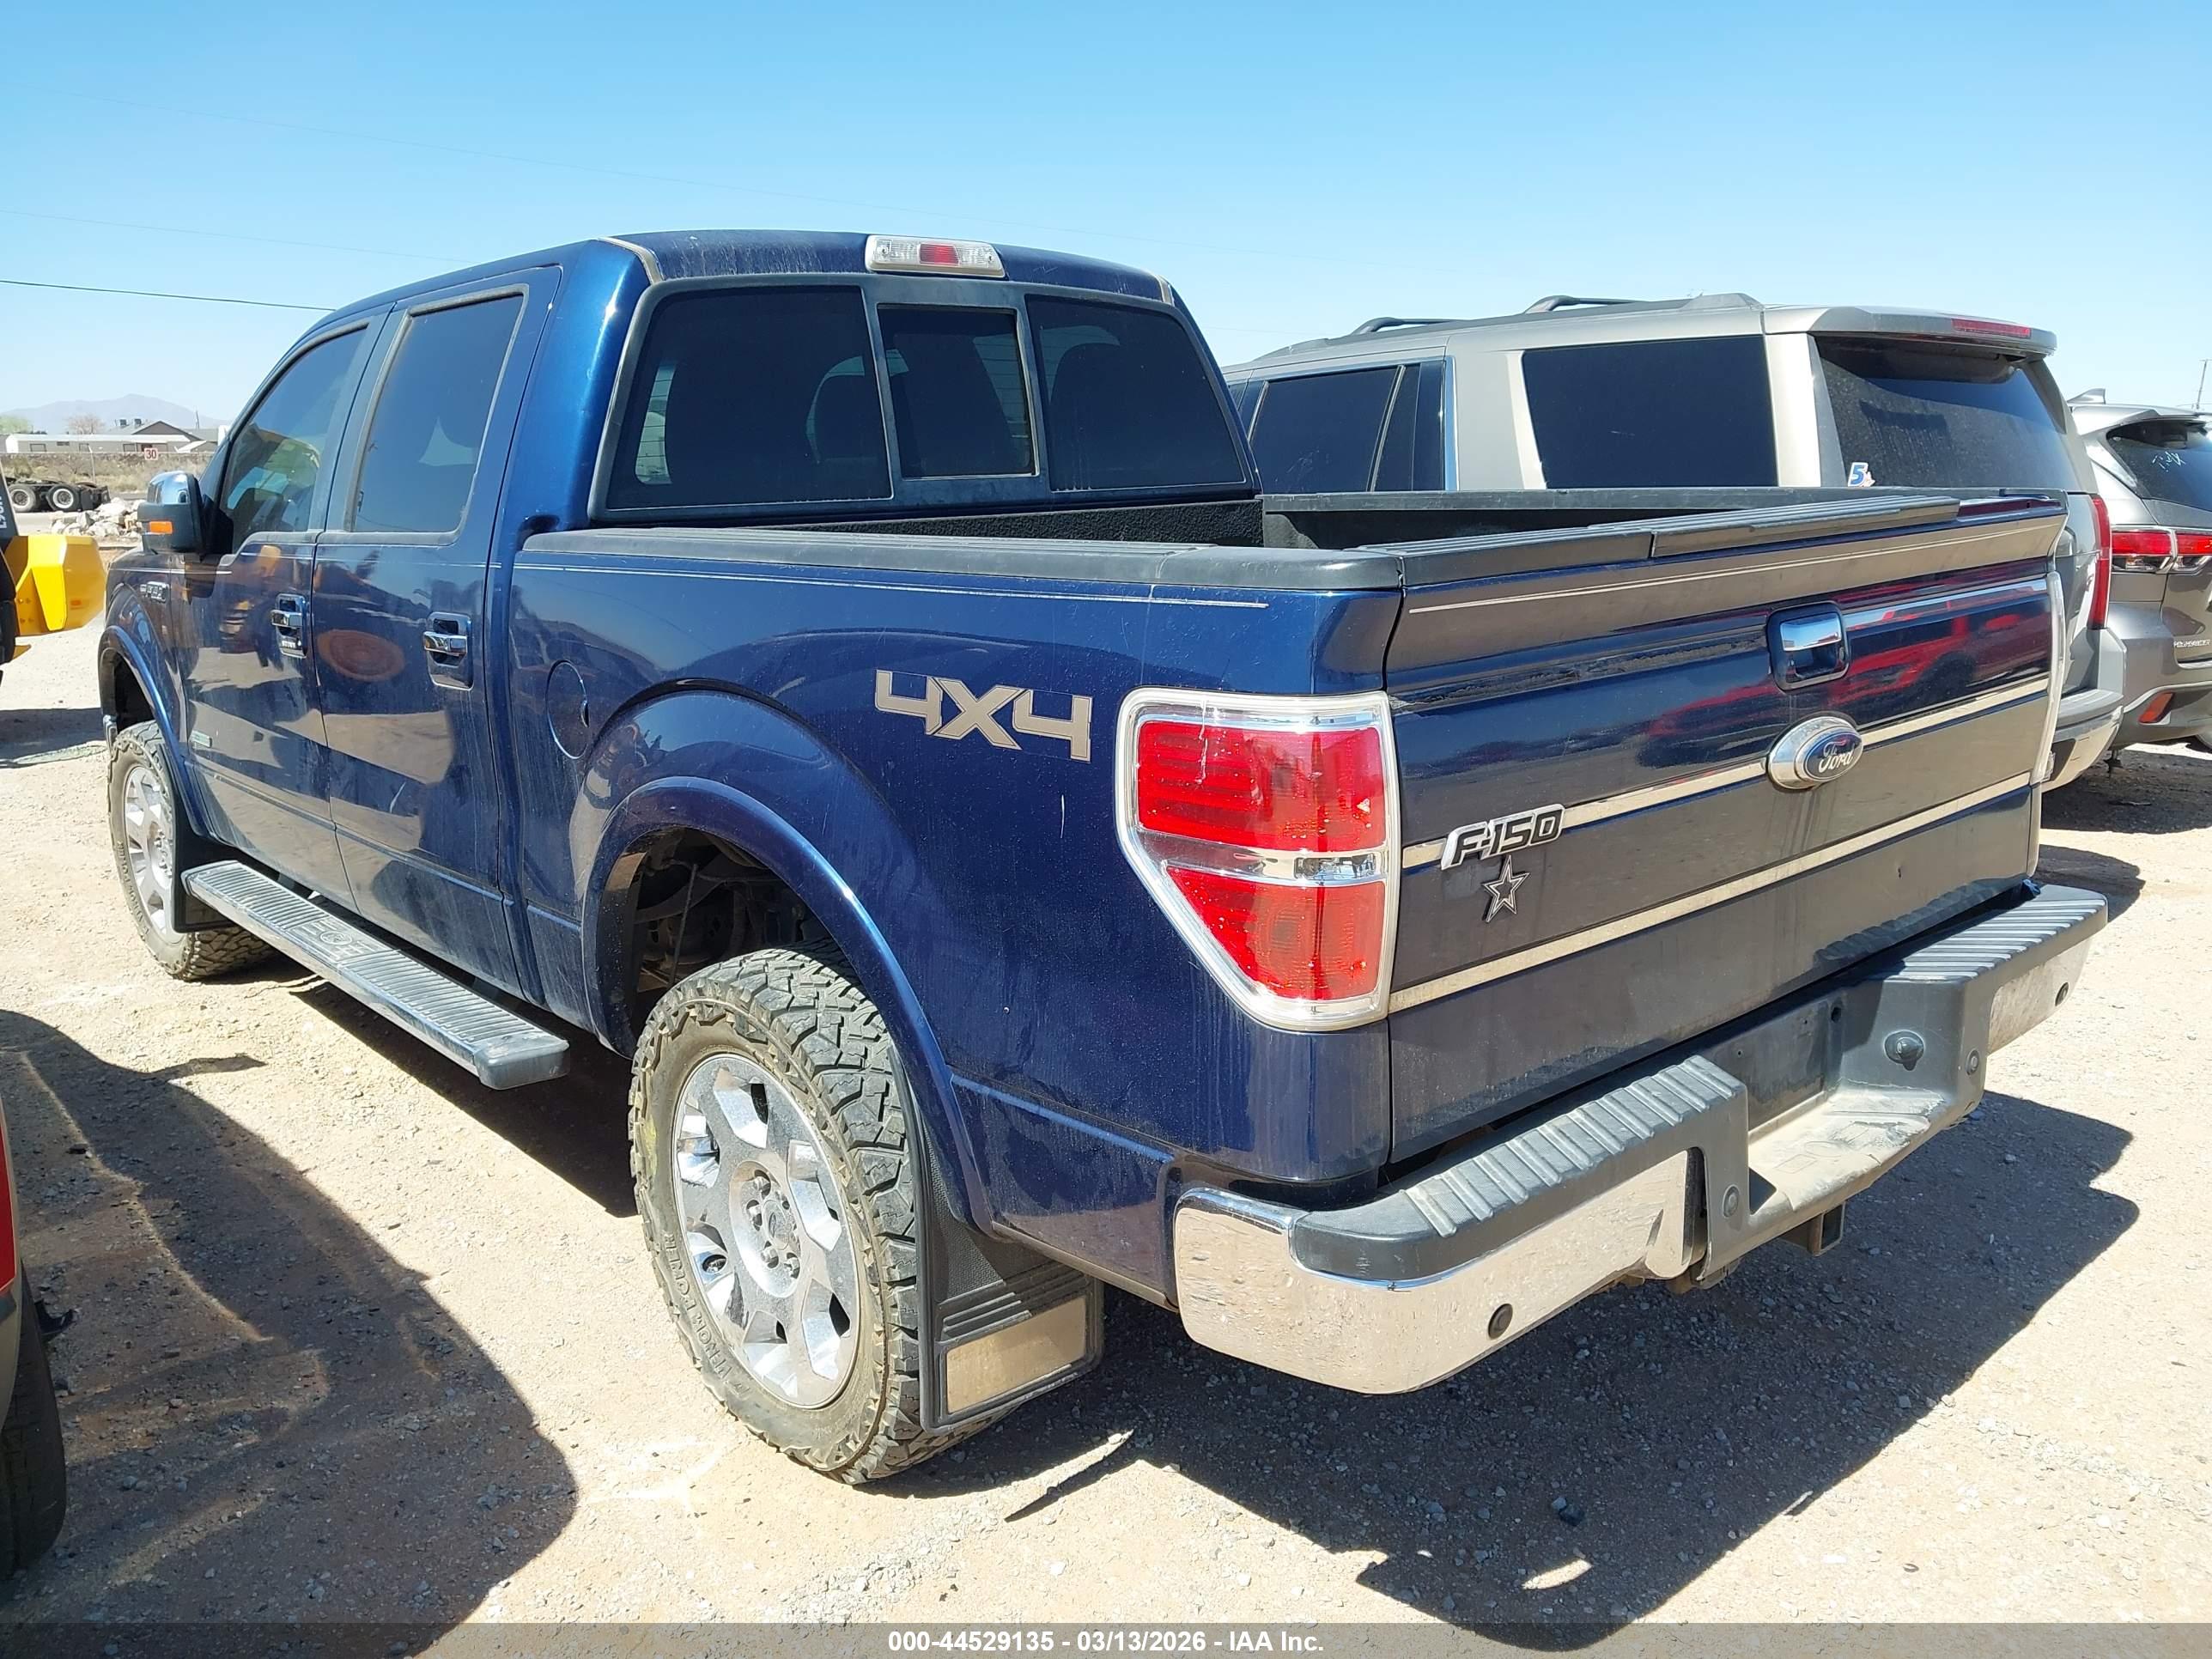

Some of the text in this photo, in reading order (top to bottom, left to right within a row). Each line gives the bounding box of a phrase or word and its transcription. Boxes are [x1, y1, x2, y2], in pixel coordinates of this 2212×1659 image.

[145, 449, 157, 459] 30
[1818, 738, 1856, 774] Ford
[1444, 805, 1565, 869] F-150
[663, 1230, 733, 1380] VENOM POWER
